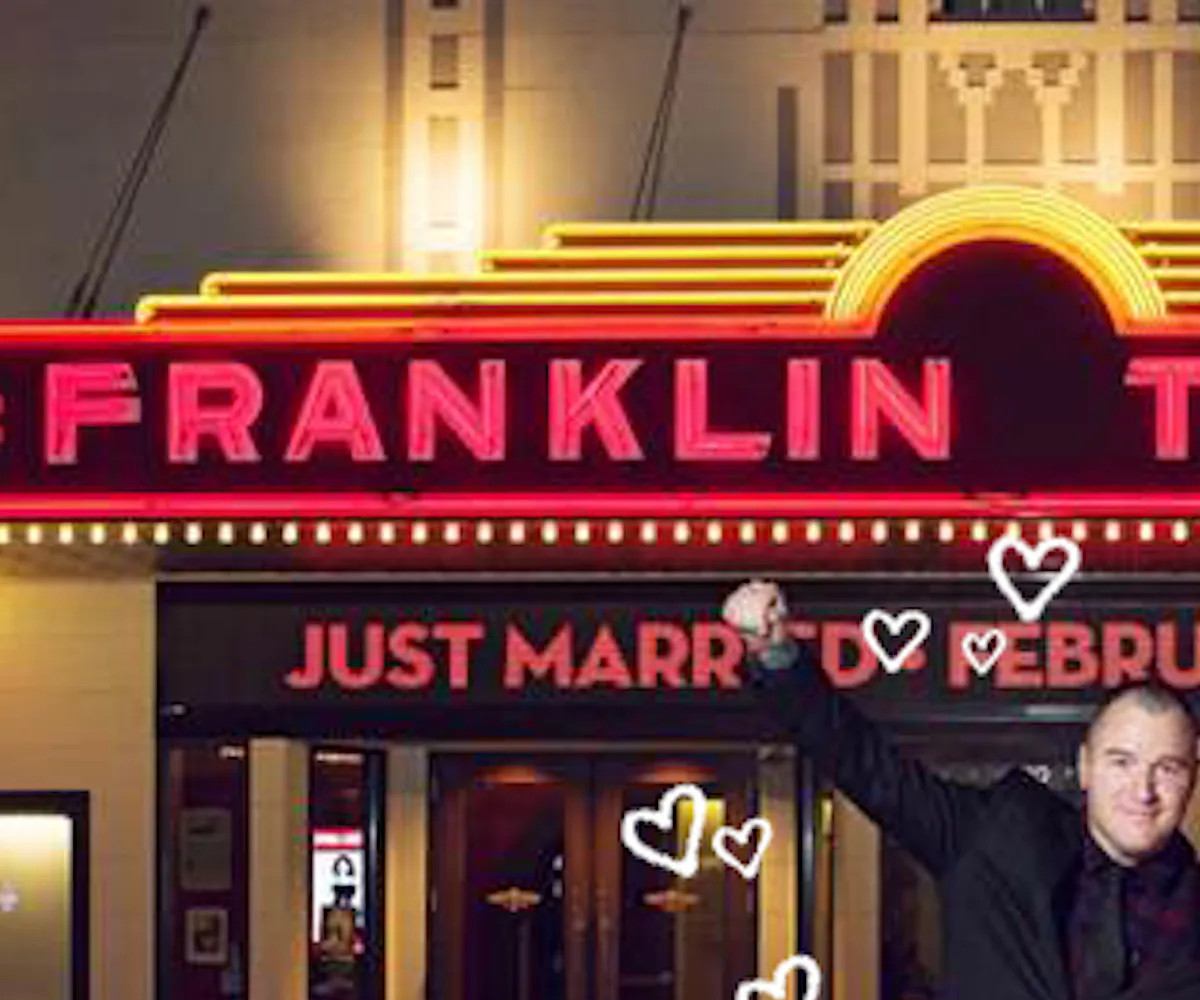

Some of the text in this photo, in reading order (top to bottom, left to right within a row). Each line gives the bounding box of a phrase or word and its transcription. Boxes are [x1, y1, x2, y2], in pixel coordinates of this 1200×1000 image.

[46, 358, 951, 464] FRANKLIN
[286, 622, 484, 688] JUST
[504, 621, 877, 687] MARRD
